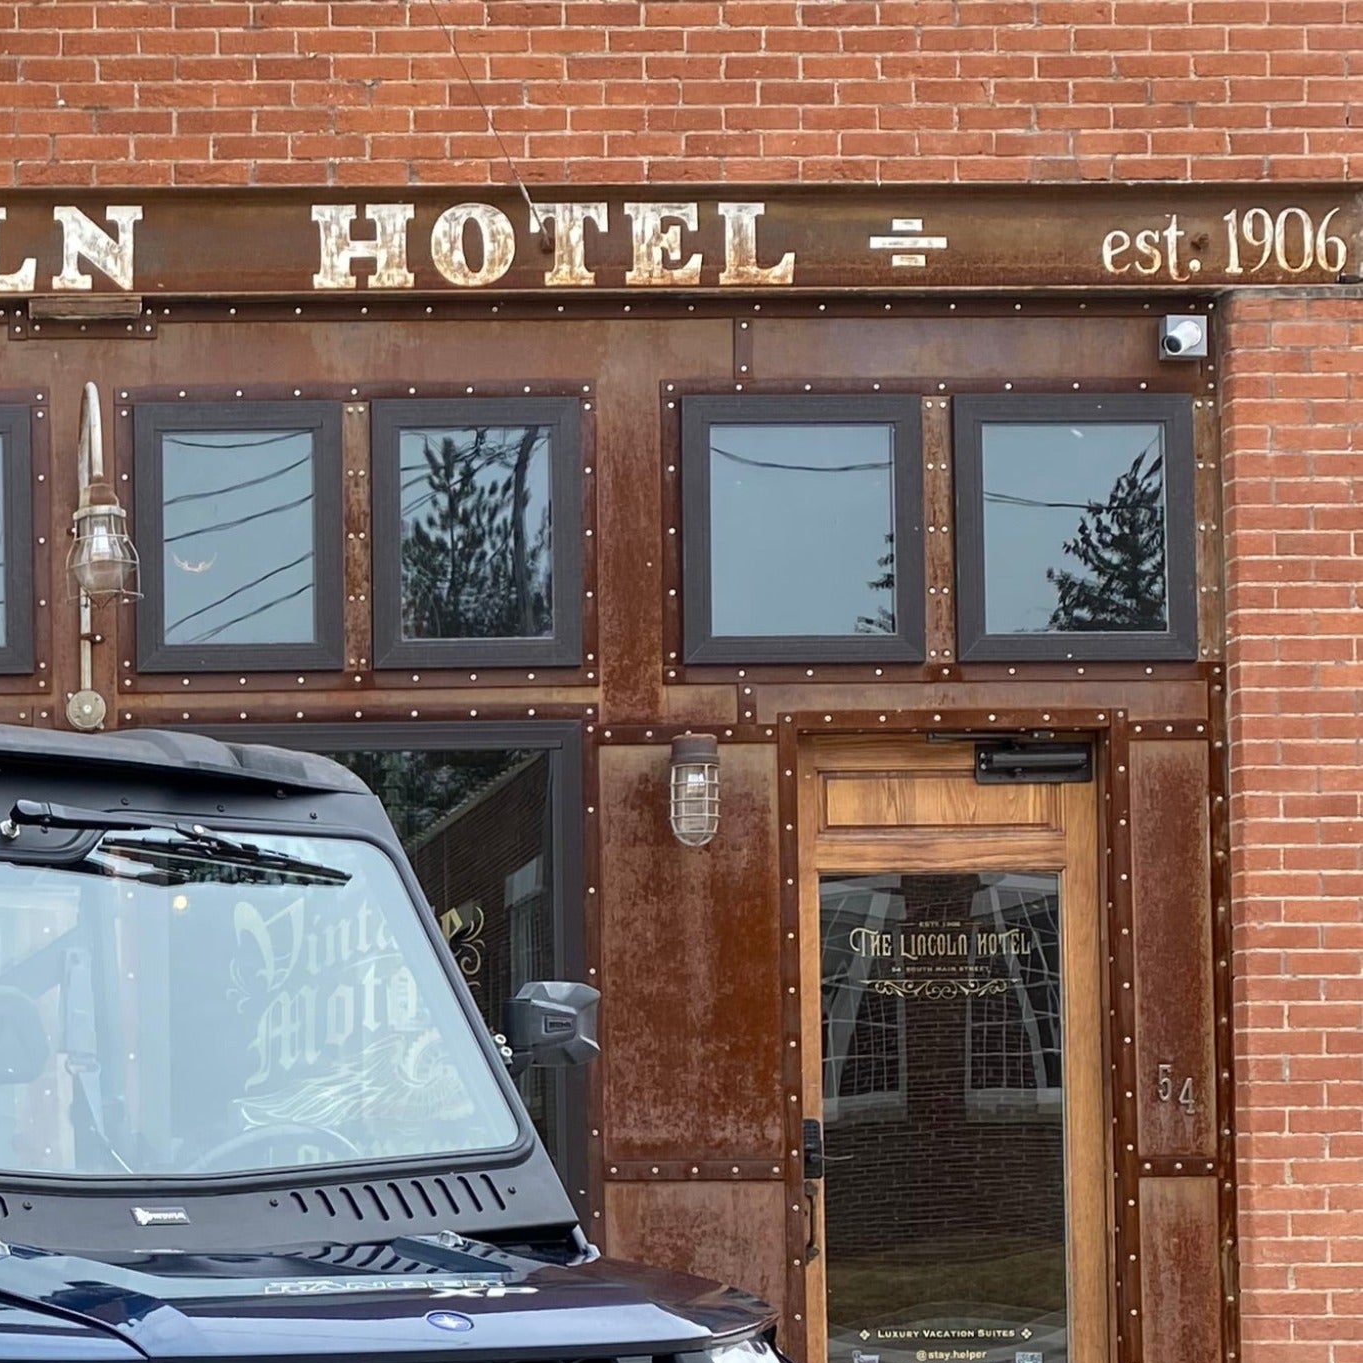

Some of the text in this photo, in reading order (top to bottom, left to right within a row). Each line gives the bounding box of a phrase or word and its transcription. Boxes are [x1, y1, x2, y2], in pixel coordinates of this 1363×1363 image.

[309, 202, 797, 290] HOTEL
[1100, 206, 1348, 281] est. 1906
[1158, 1064, 1195, 1114] 54
